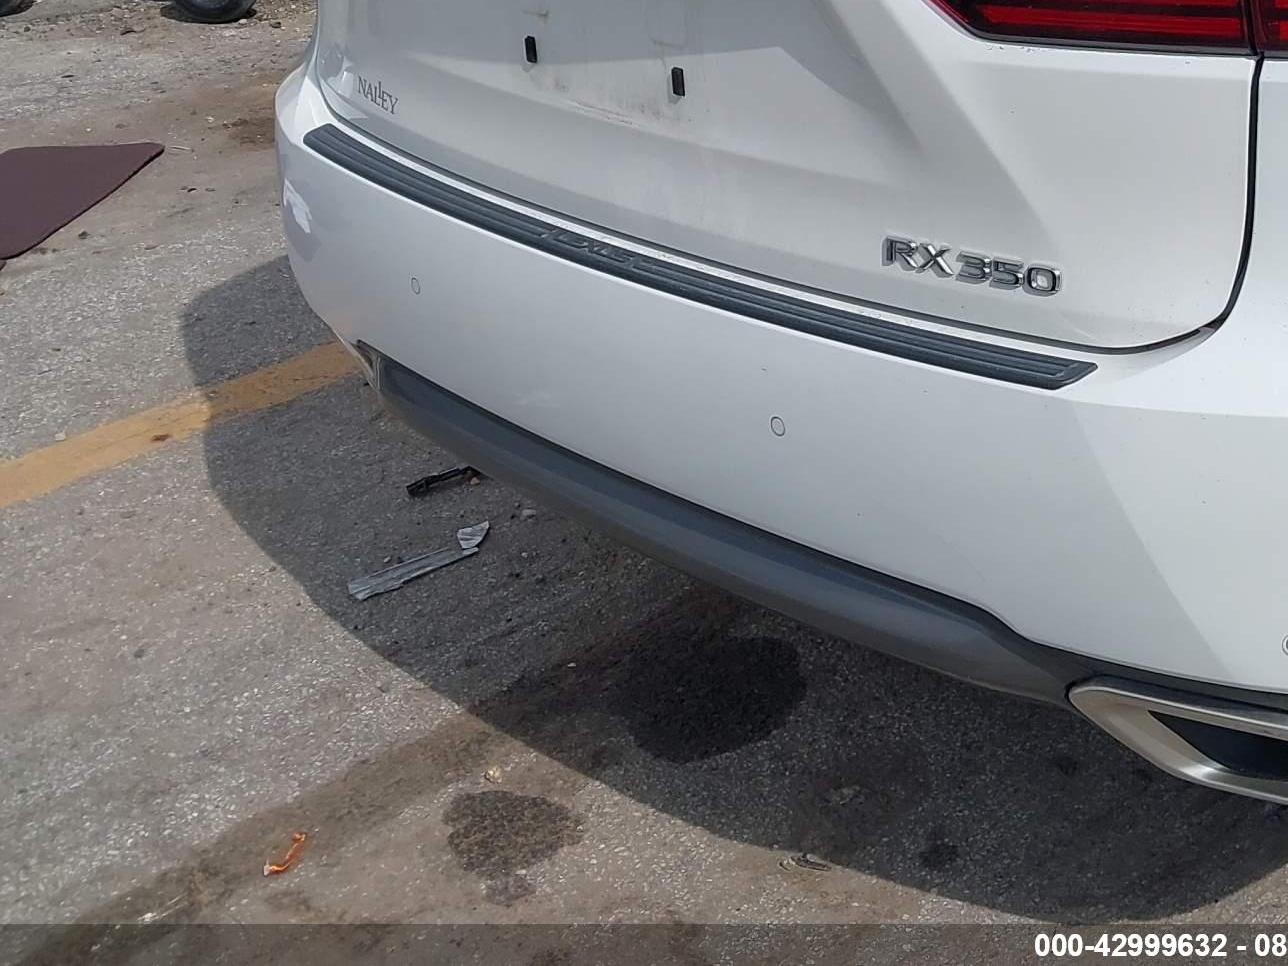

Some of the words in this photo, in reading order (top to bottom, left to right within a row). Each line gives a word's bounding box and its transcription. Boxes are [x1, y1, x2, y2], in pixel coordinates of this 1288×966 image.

[357, 74, 399, 115] NALLEY
[881, 235, 954, 278] RX
[955, 249, 1063, 297] 350
